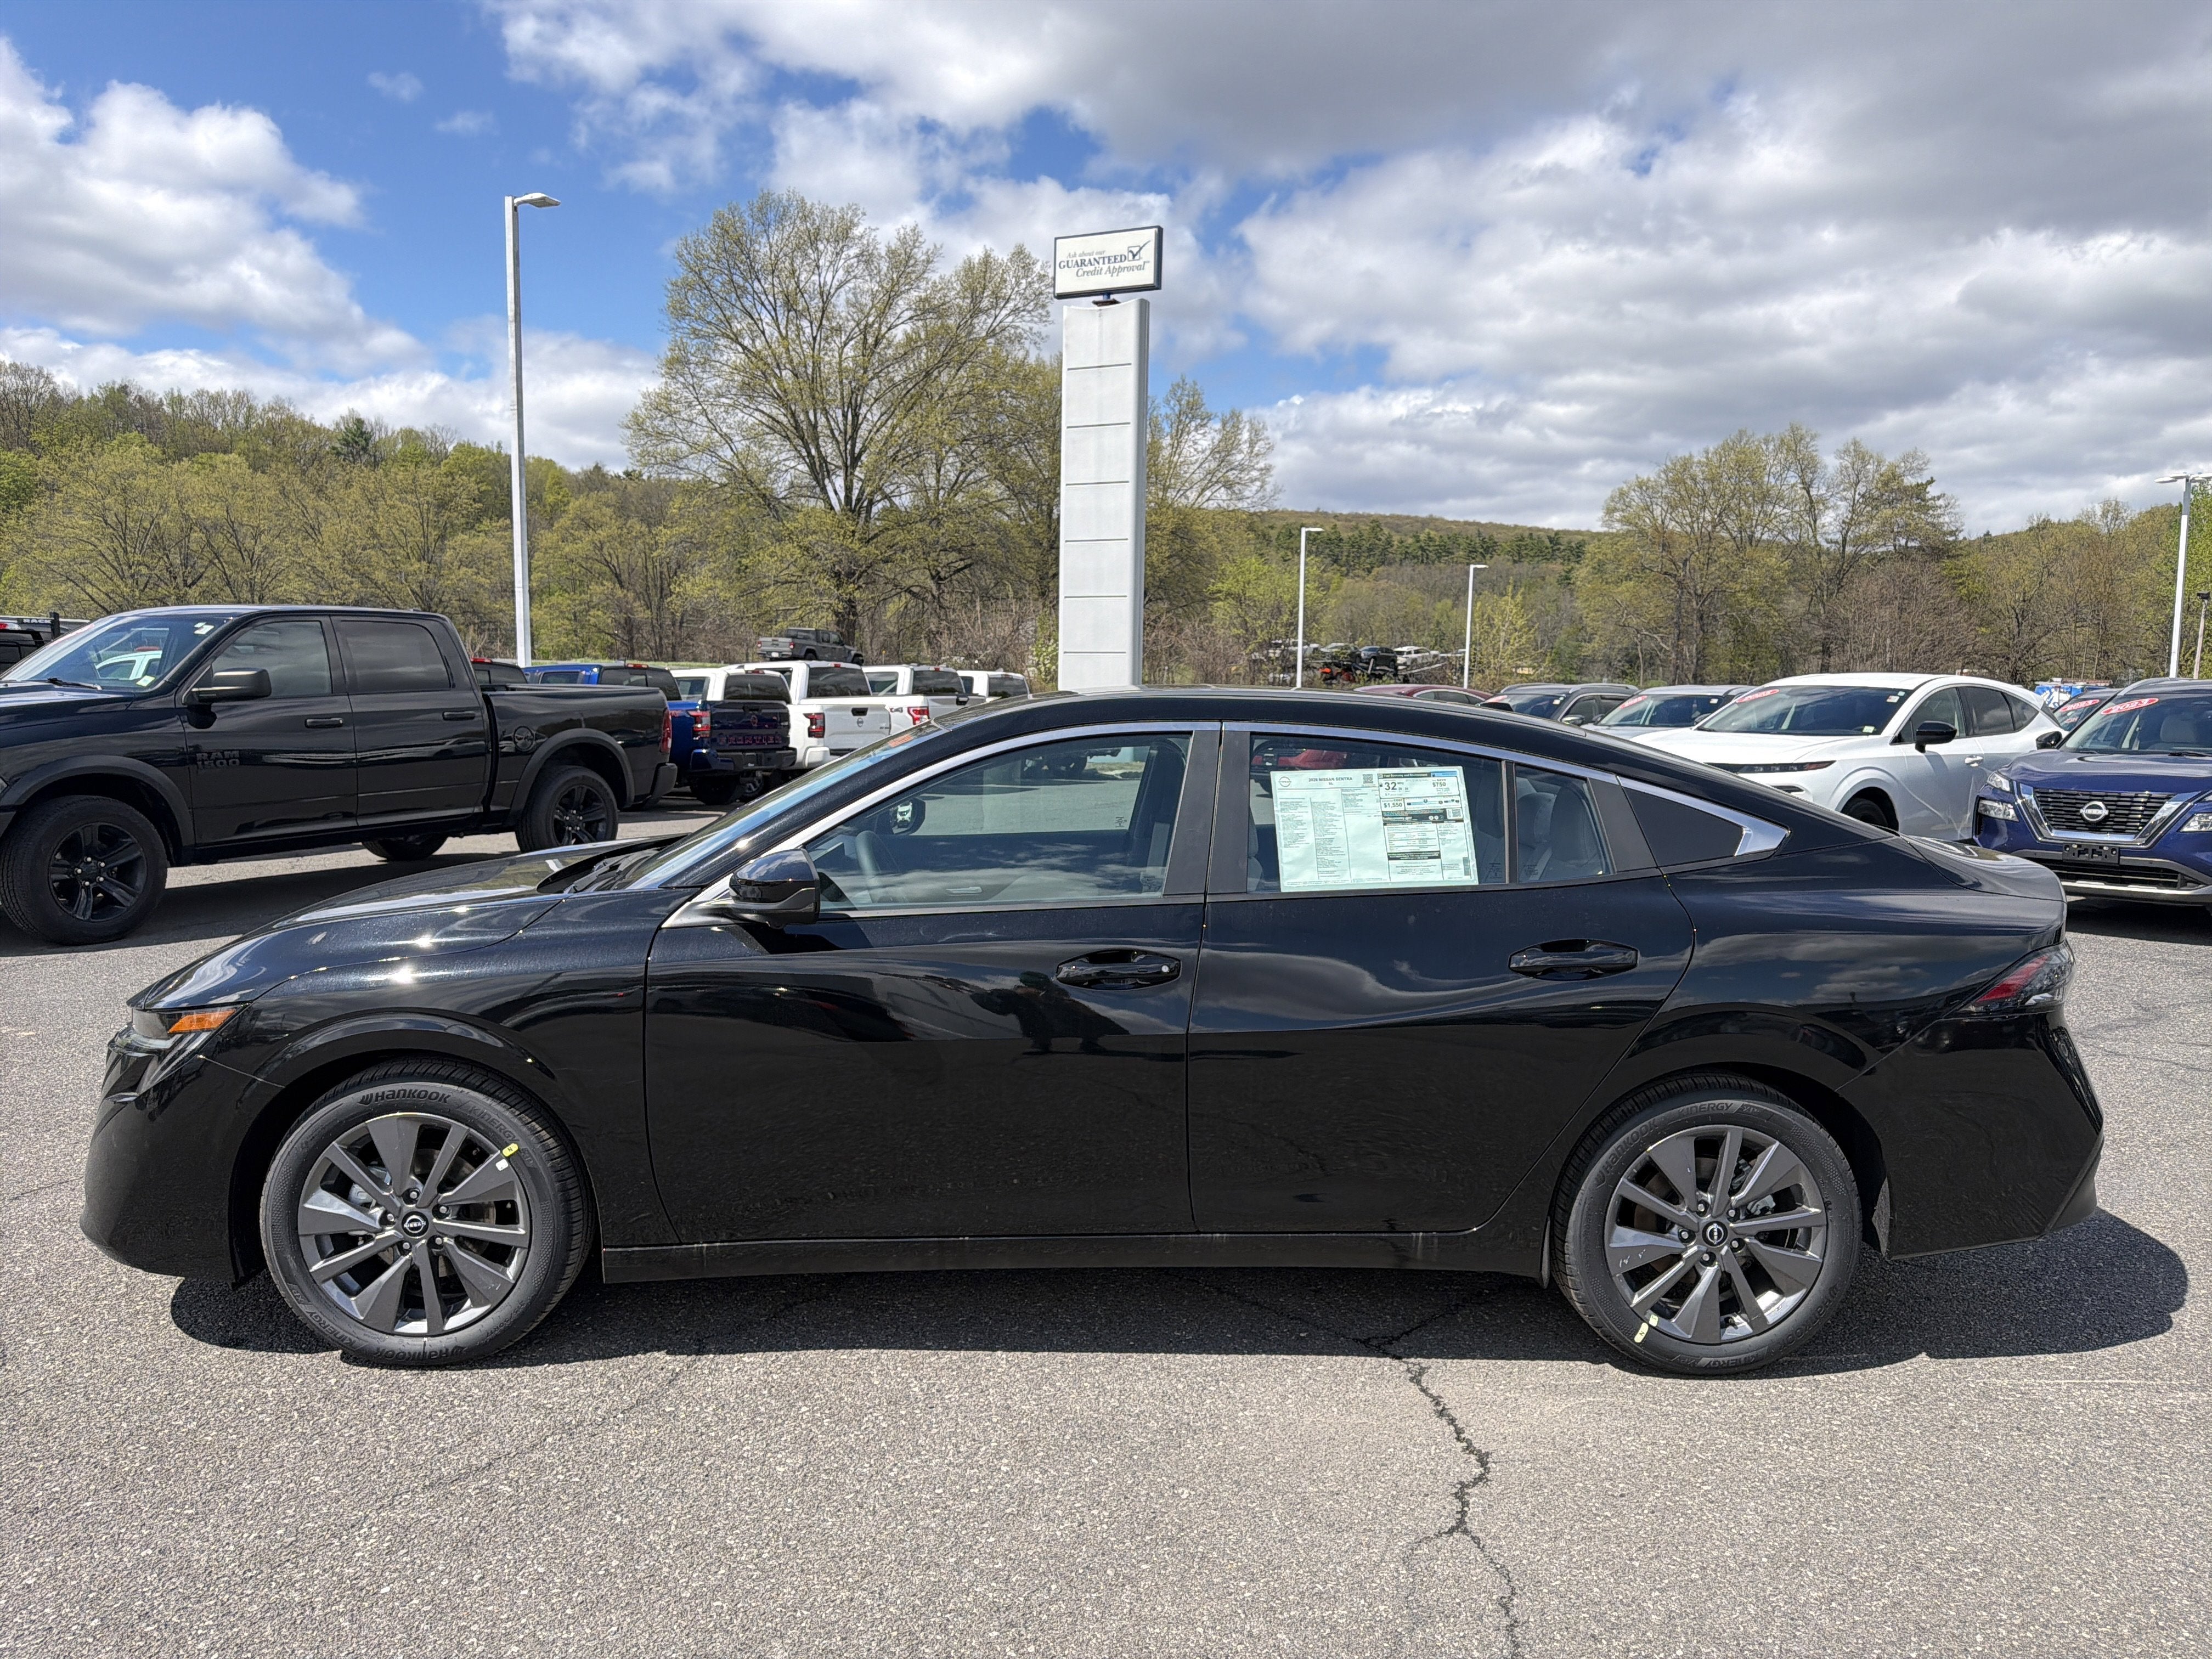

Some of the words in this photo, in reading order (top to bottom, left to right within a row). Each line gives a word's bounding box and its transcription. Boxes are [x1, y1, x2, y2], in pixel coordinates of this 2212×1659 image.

[1058, 254, 1127, 269] GUARANTEED
[1076, 267, 1103, 278] Credit
[1104, 261, 1146, 278] Approval
[196, 751, 239, 760] RAM
[1384, 782, 1397, 791] 32
